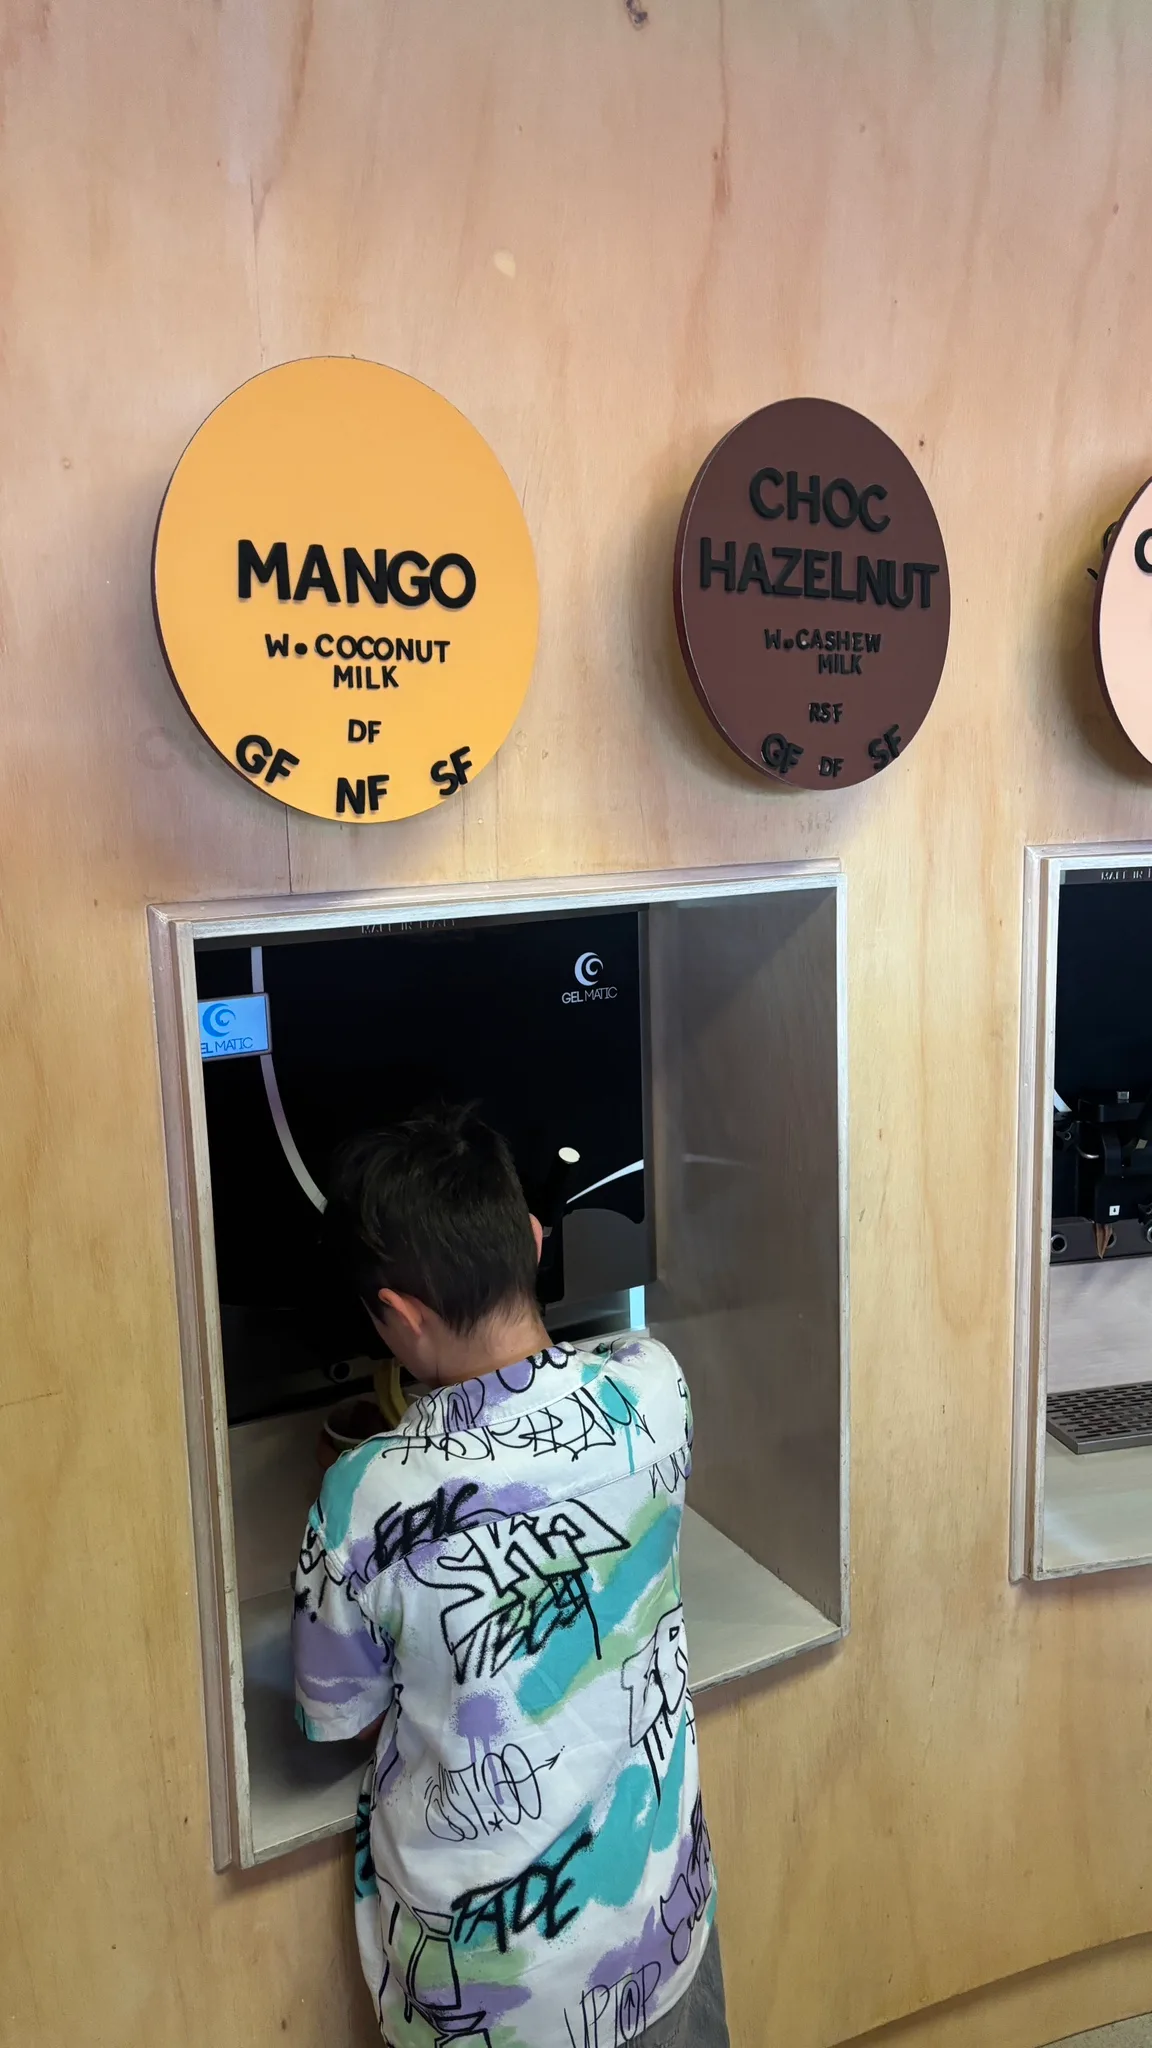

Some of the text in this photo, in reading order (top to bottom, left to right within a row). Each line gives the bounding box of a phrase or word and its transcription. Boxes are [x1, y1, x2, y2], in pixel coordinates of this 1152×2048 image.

[749, 467, 891, 533] CHOC
[237, 539, 477, 610] MANGO
[699, 536, 940, 609] HAZELNUT
[333, 664, 399, 690] MILK
[818, 653, 862, 675] MILK
[348, 718, 382, 743] DF
[808, 702, 843, 724] RSF
[761, 723, 901, 777] GF DF SF
[235, 734, 473, 815] GF NF SF
[561, 986, 618, 1004] GEL MATIC
[200, 1036, 254, 1055] EL MATIC
[451, 1829, 594, 1954] FADE
